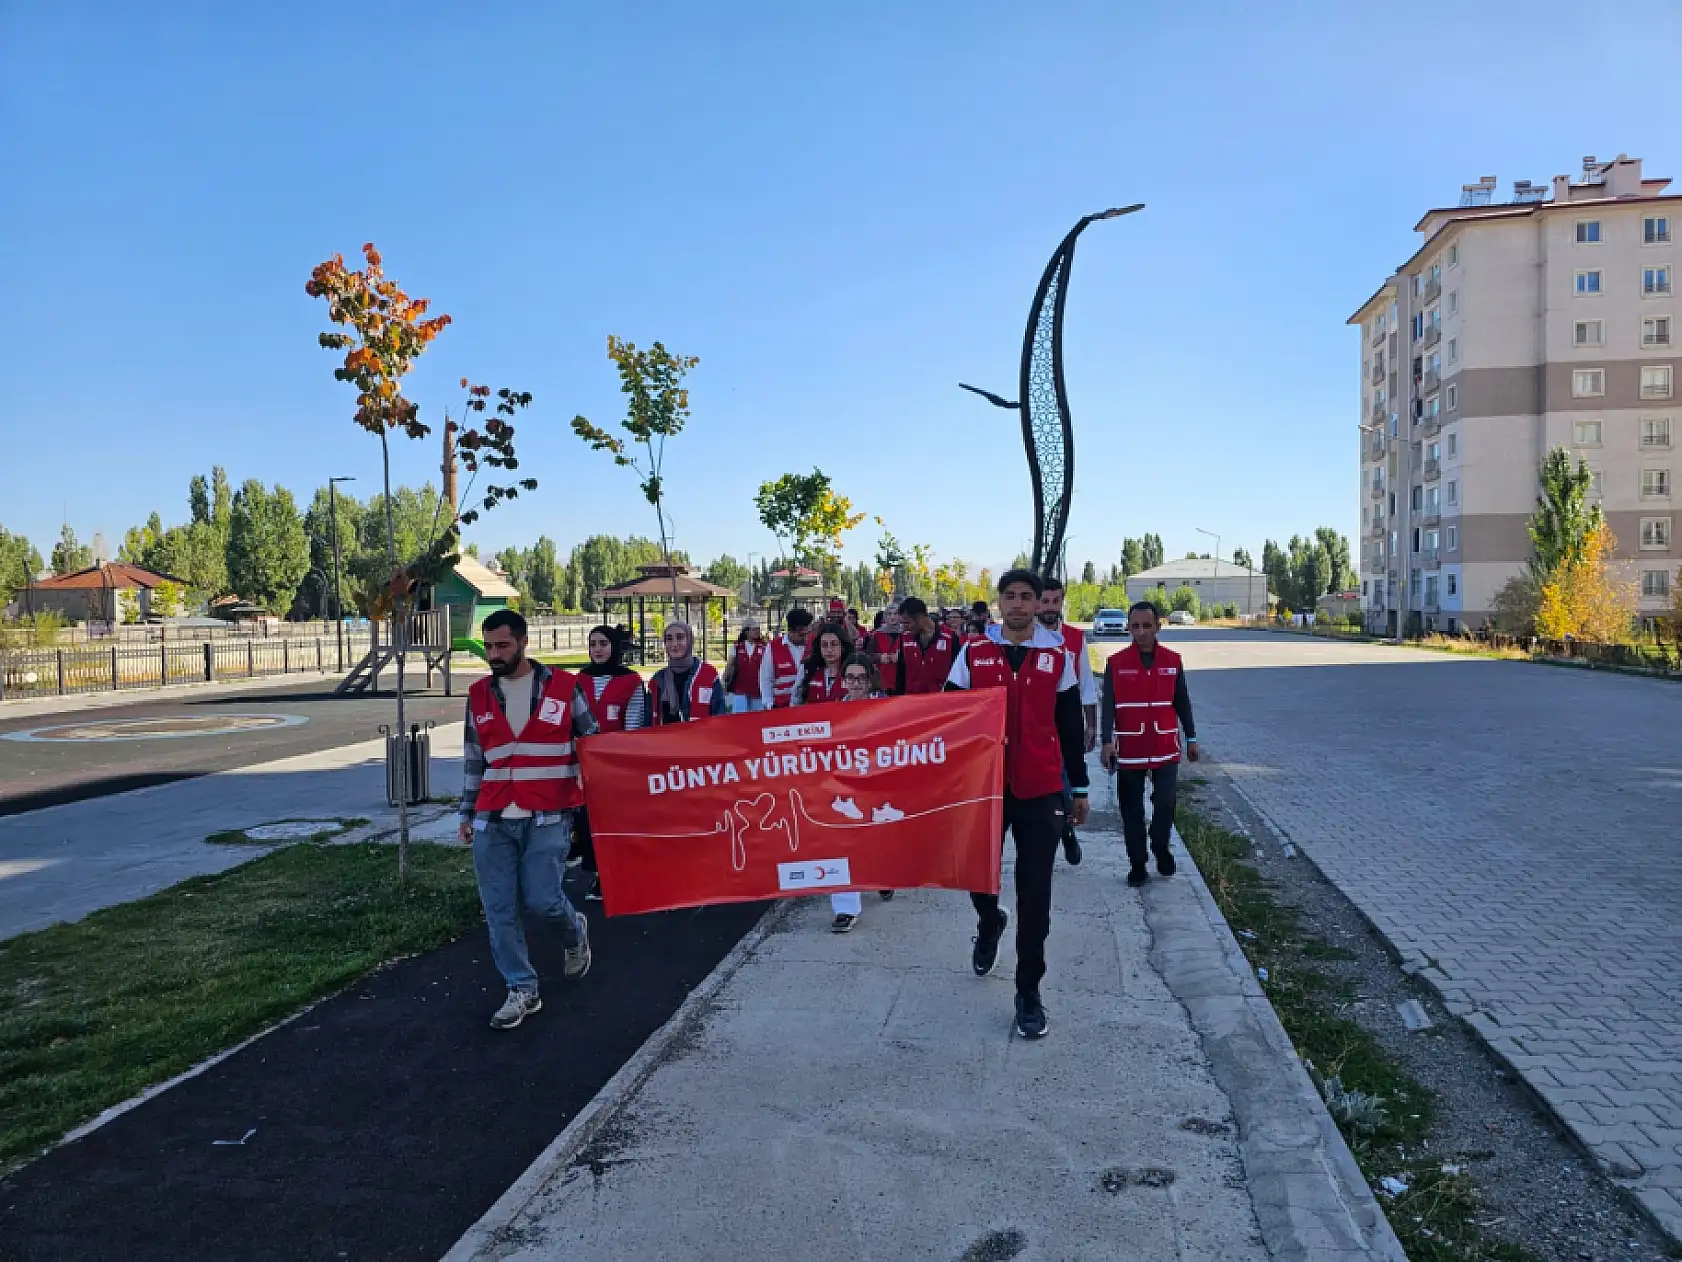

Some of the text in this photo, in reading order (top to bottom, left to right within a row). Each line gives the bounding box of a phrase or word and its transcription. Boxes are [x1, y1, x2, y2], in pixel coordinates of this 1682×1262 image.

[648, 736, 946, 795] DÜNYA YÜRÜYÜŞ GÜNÜ
